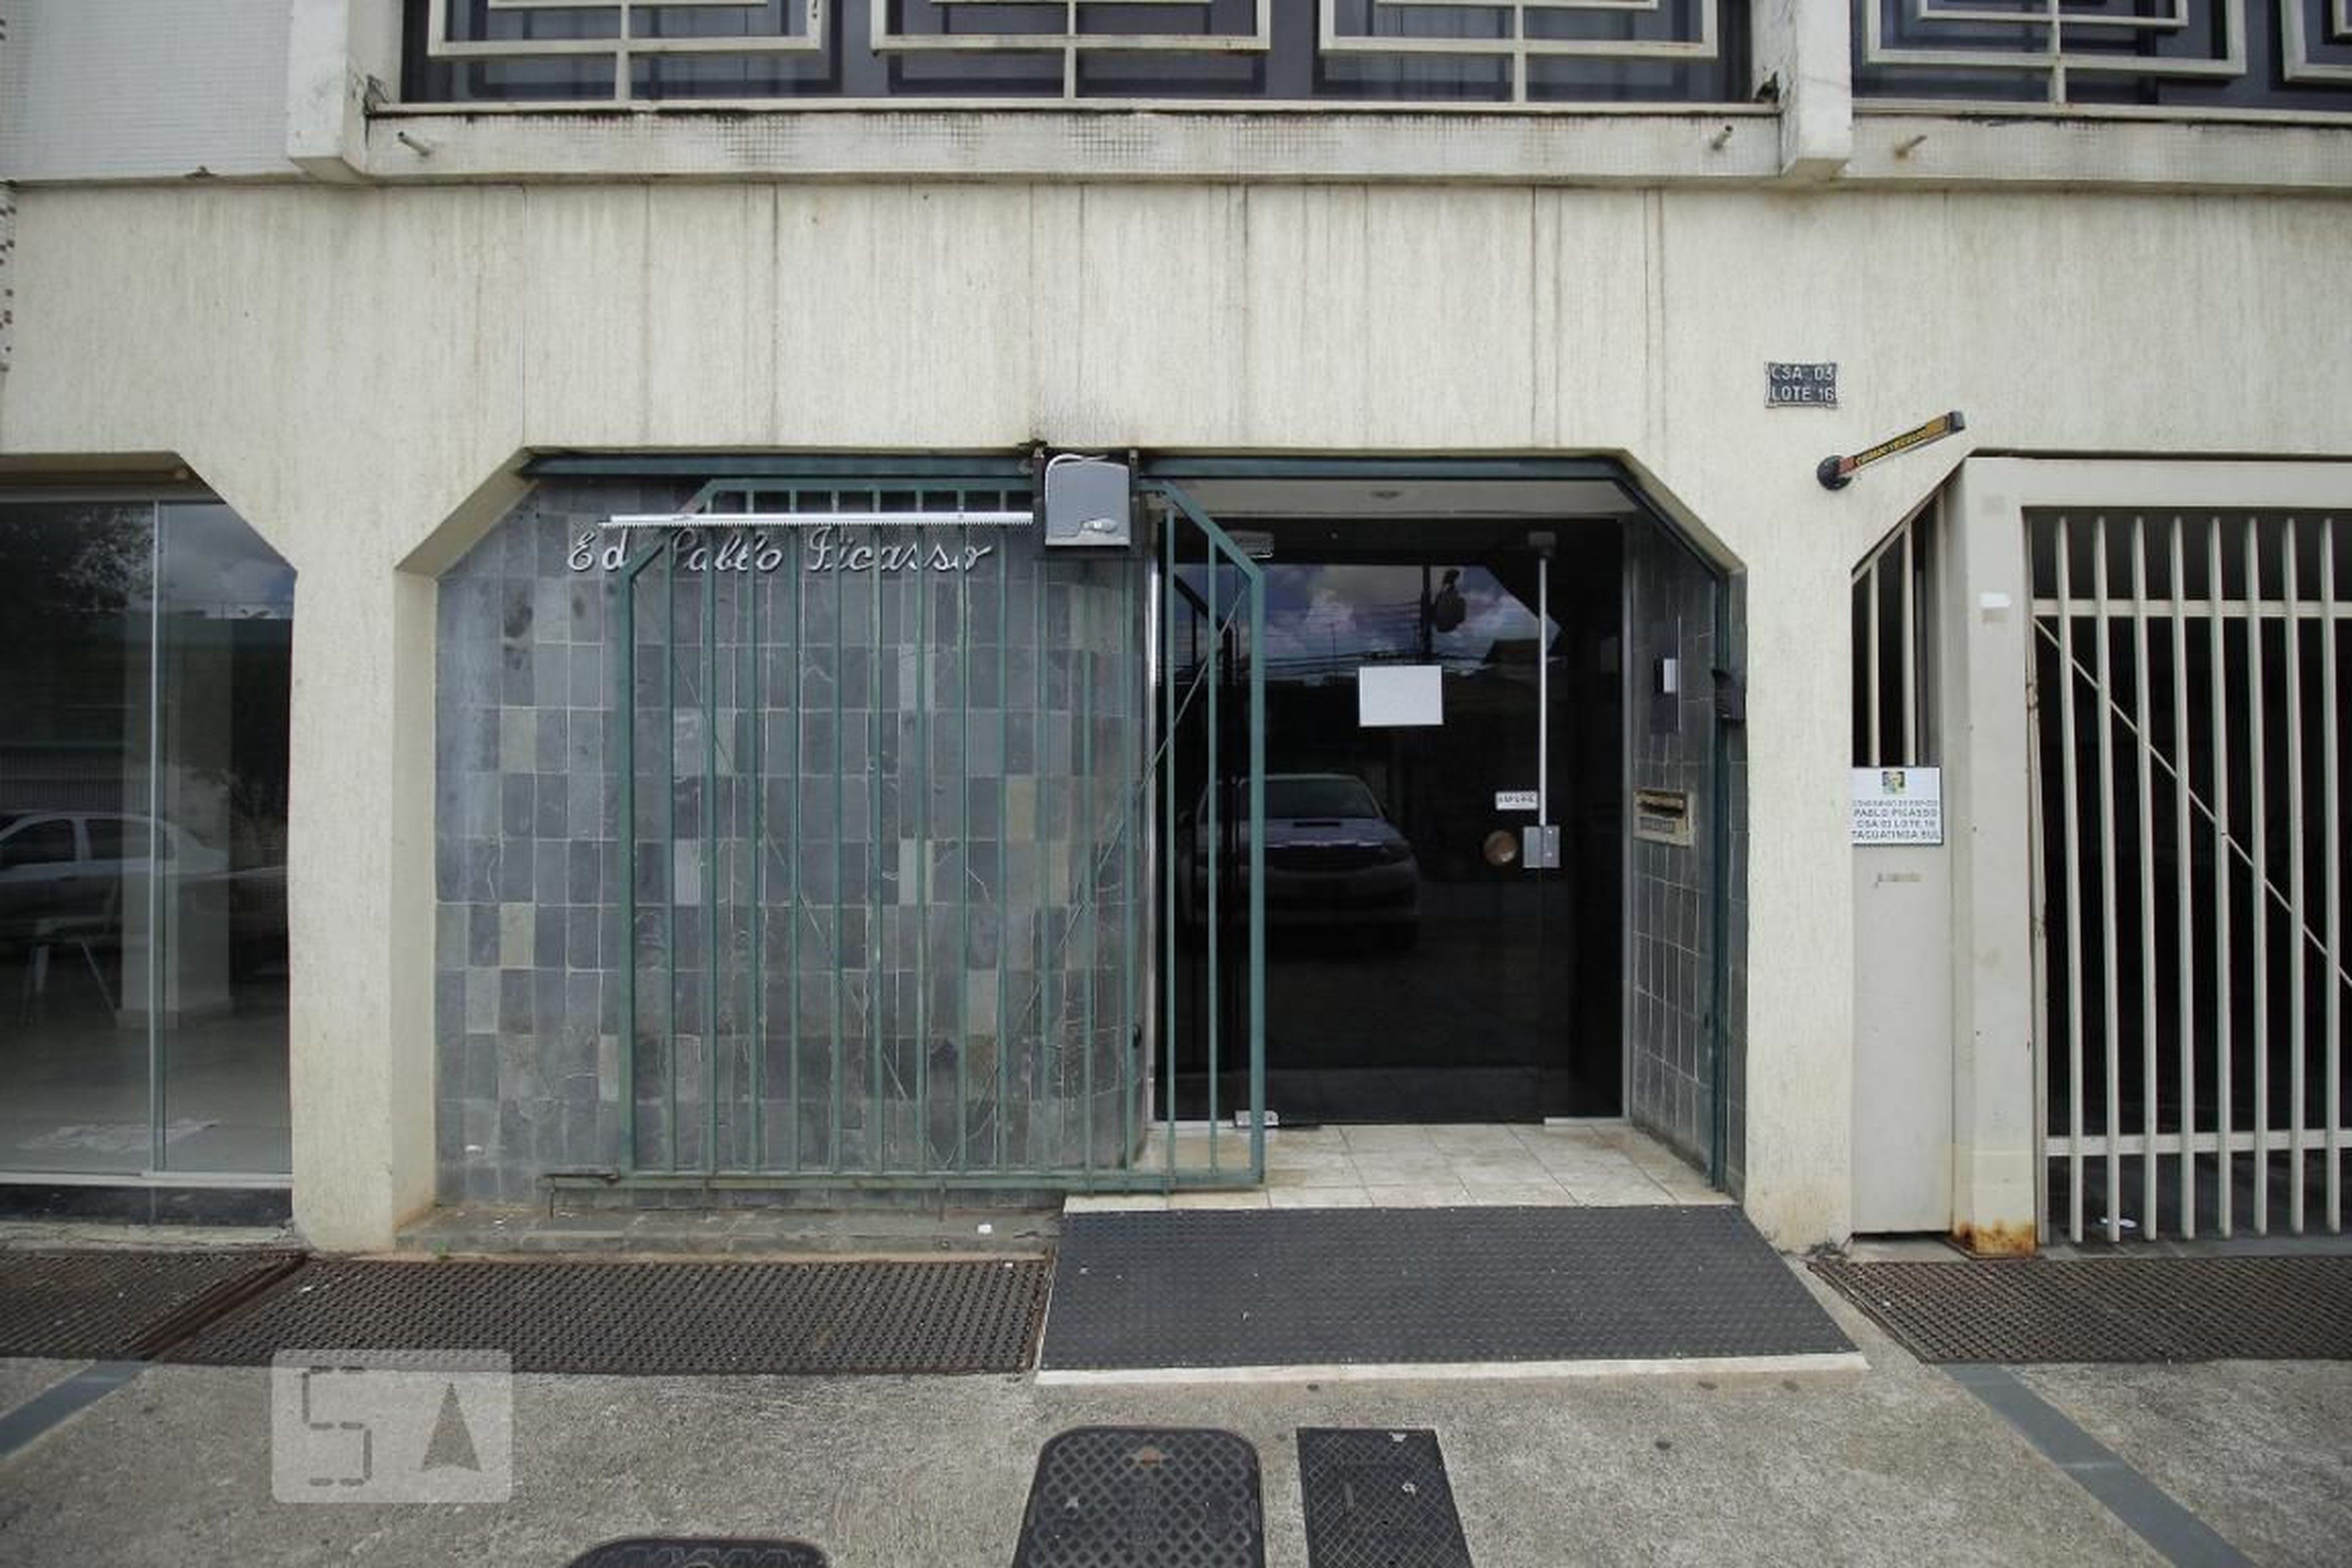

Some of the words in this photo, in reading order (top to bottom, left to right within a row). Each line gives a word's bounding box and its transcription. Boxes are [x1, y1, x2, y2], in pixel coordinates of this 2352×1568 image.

[1771, 365, 1803, 380] CSA
[1771, 385, 1811, 401] LOTE
[1819, 386, 1834, 401] 16
[1853, 808, 1889, 817] PABLO
